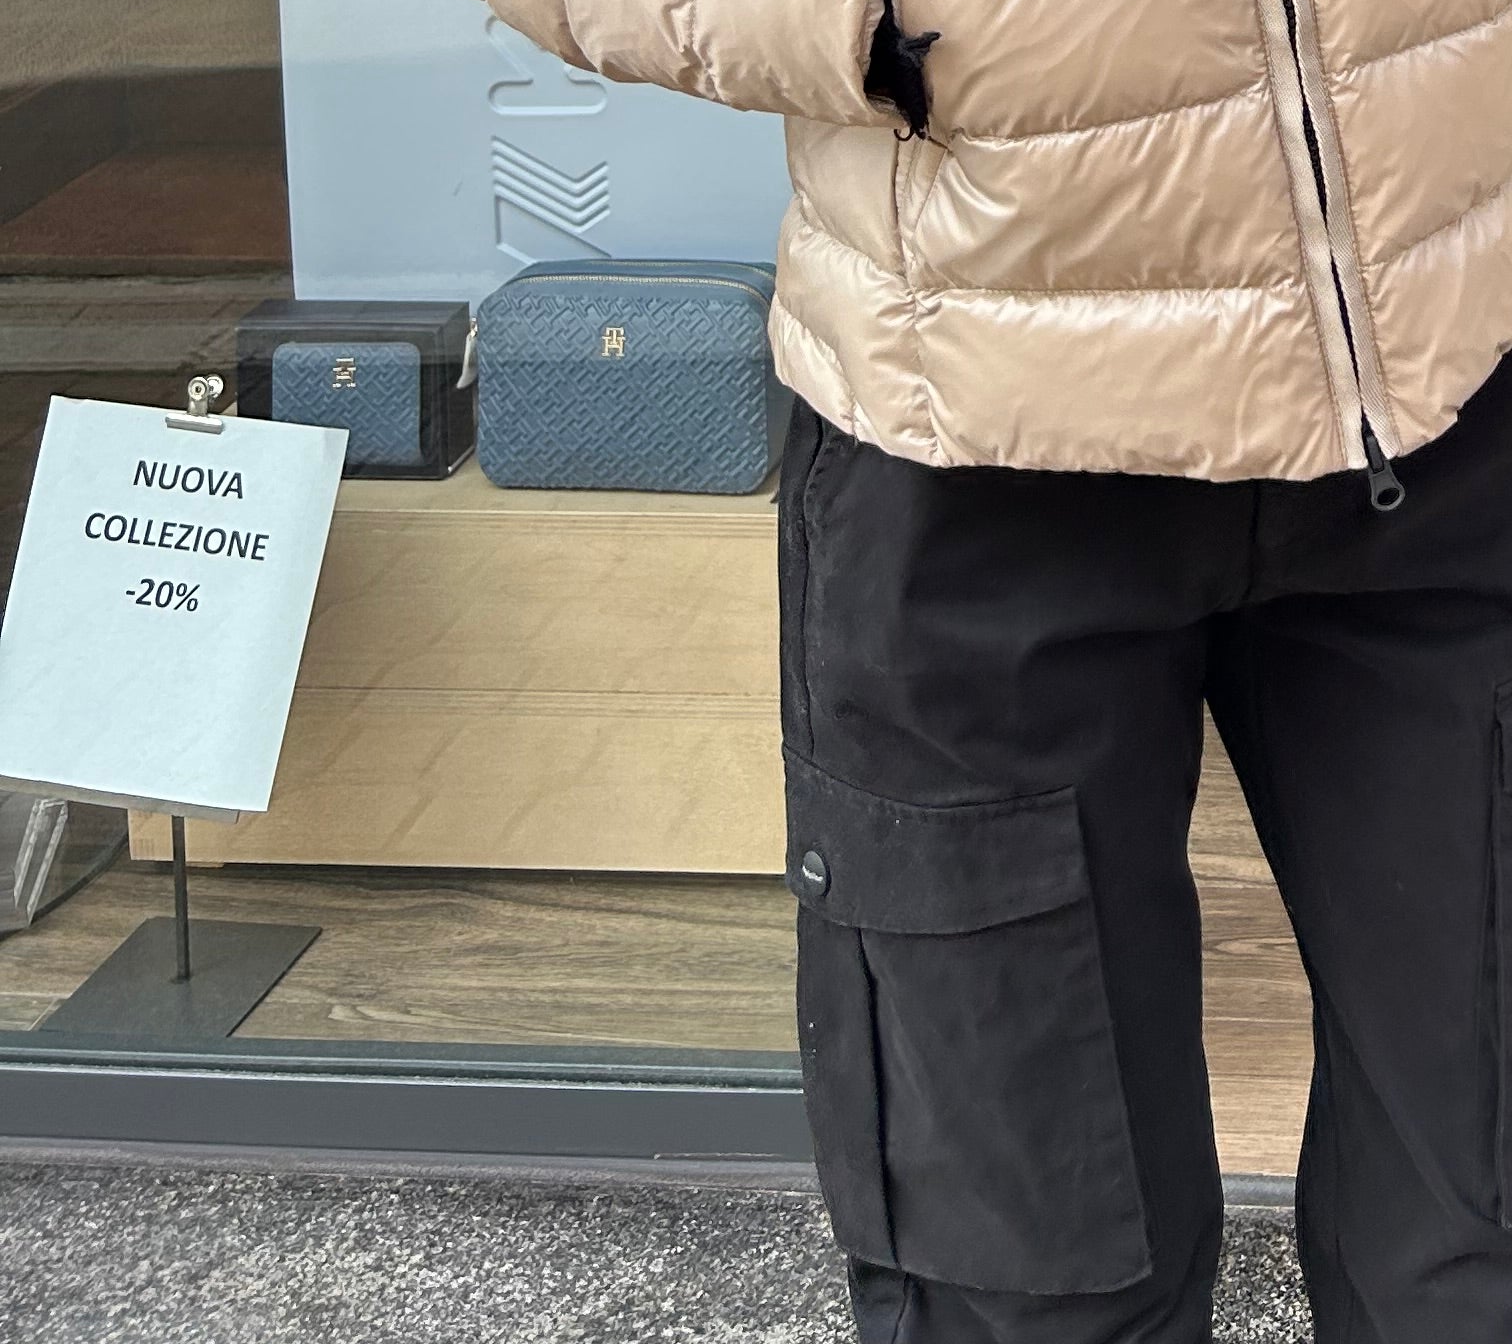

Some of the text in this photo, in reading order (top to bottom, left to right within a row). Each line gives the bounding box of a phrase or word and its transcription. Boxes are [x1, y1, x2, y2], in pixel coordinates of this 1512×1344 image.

[133, 460, 243, 499] NUOVA
[85, 512, 270, 561] COLLEZIONE
[125, 578, 201, 612] -20%
